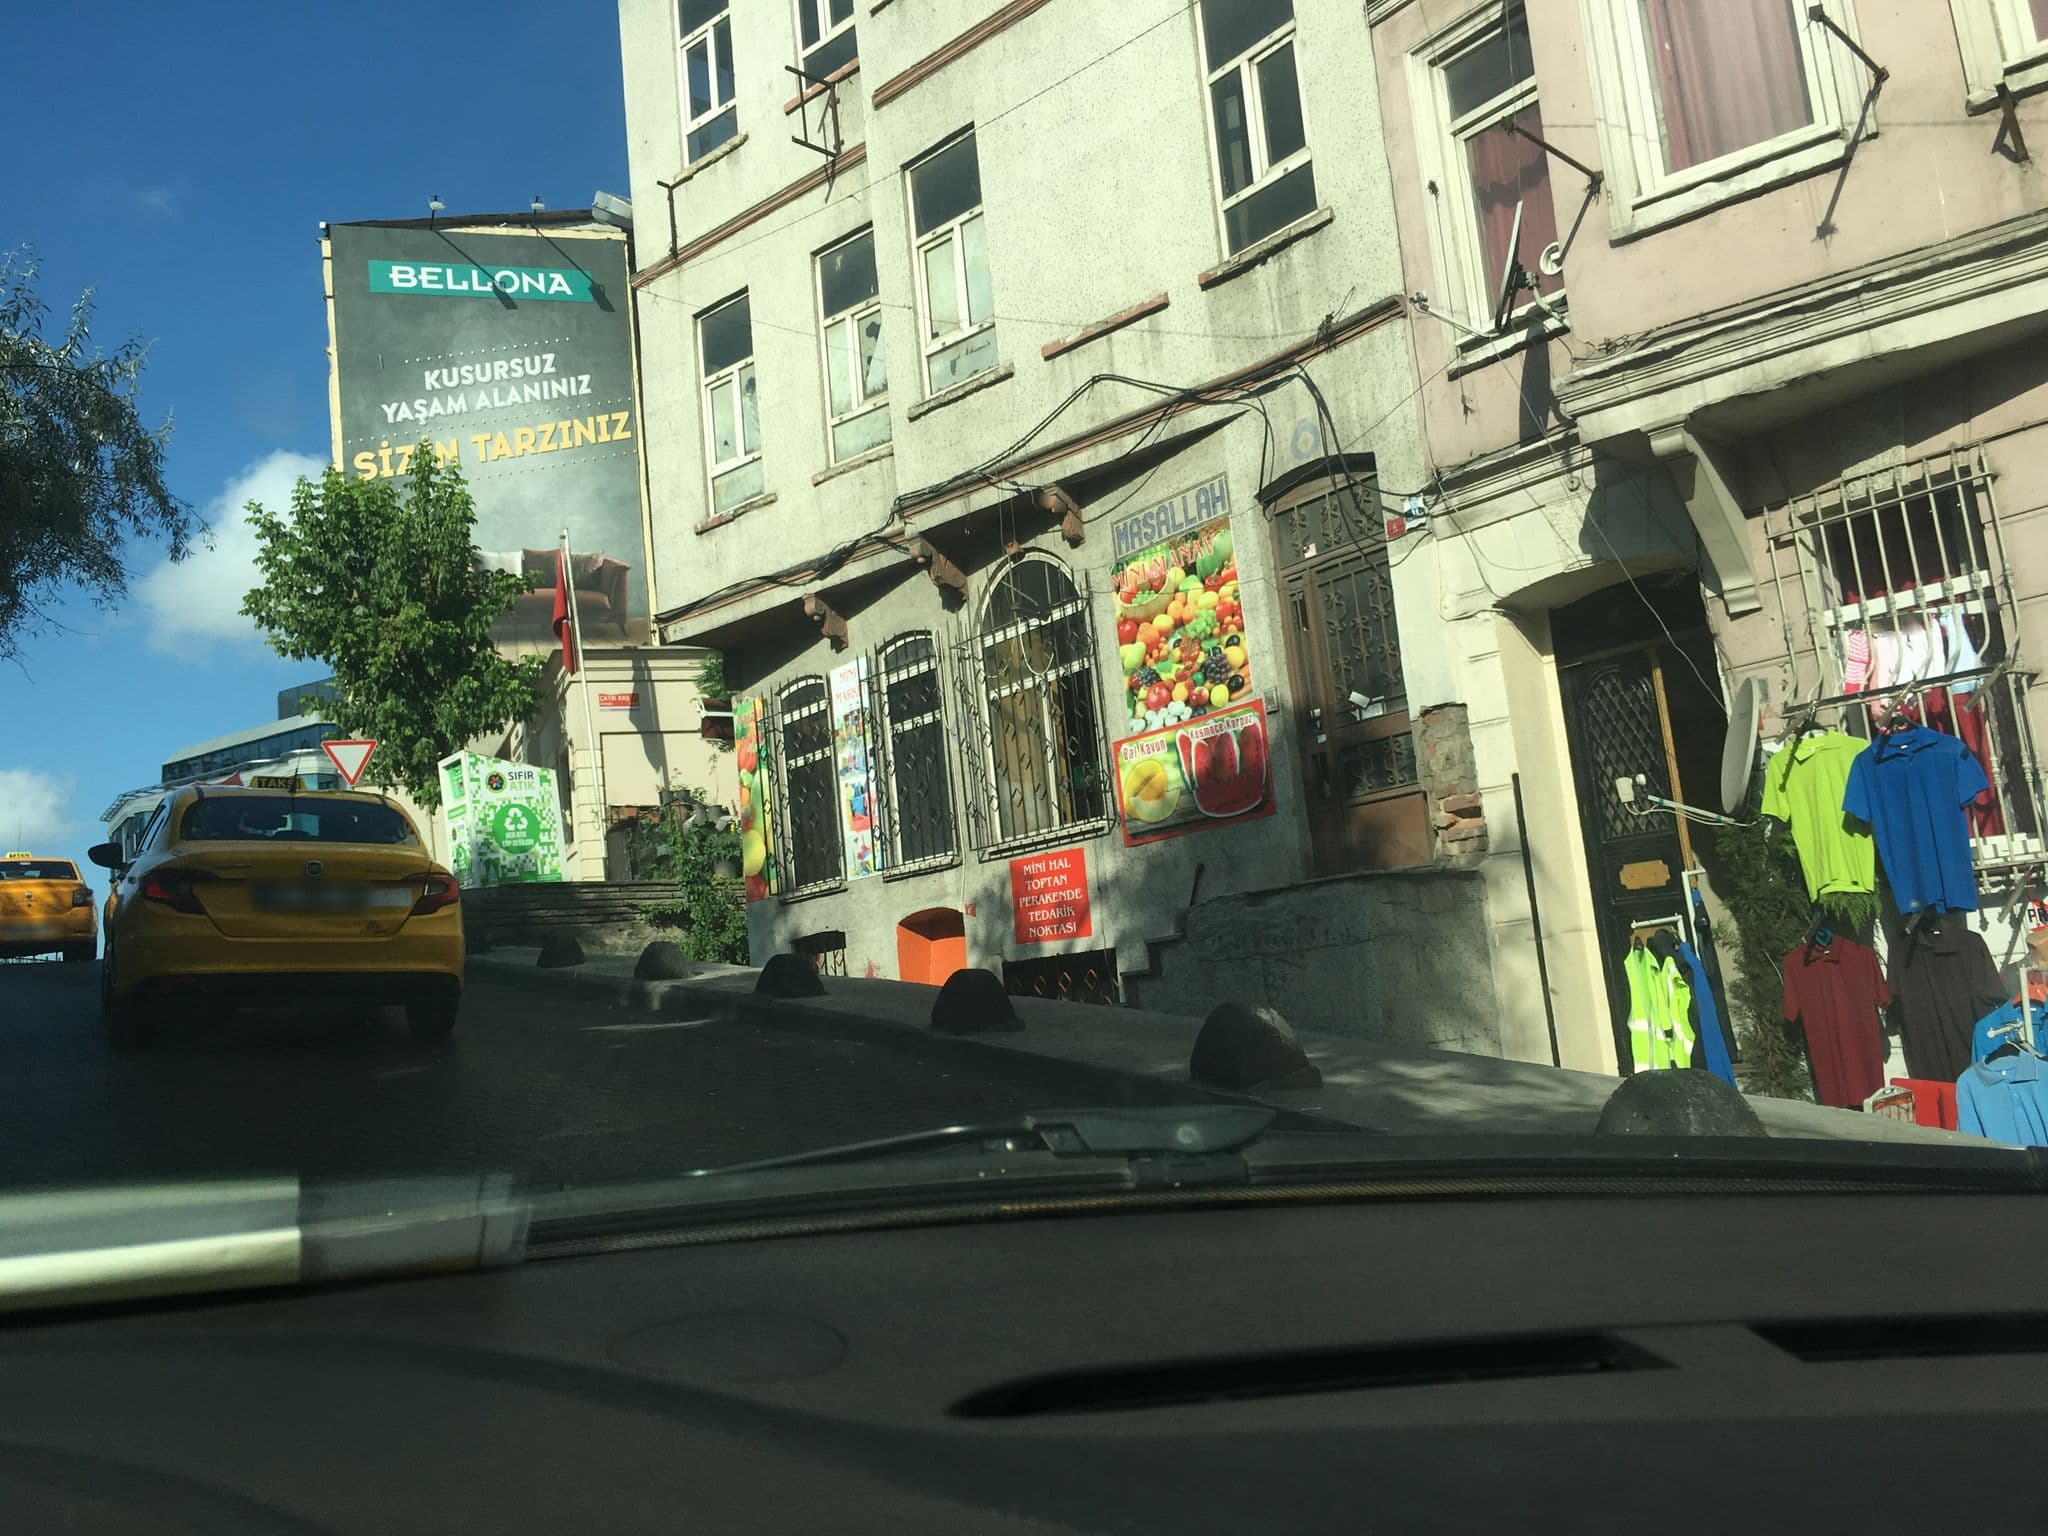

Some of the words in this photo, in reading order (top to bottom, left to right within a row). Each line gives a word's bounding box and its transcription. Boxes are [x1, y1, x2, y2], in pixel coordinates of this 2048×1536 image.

[388, 265, 573, 296] BELLONA
[424, 353, 557, 391] KUSURSUZ
[381, 393, 469, 426] YAŞAM
[475, 374, 592, 411] ALANINIZ
[472, 411, 633, 463] TARZINIZ
[1139, 740, 1166, 756] Kavun
[508, 770, 534, 781] SIFIR
[510, 780, 535, 791] ATIK
[1023, 862, 1046, 876] MİNİ
[1049, 858, 1072, 871] HAL
[1025, 874, 1068, 891] TOPTAN
[1019, 888, 1082, 908] PERAKENDE
[1028, 904, 1075, 922] TEDARİK
[1029, 921, 1077, 938] NOKTASI
